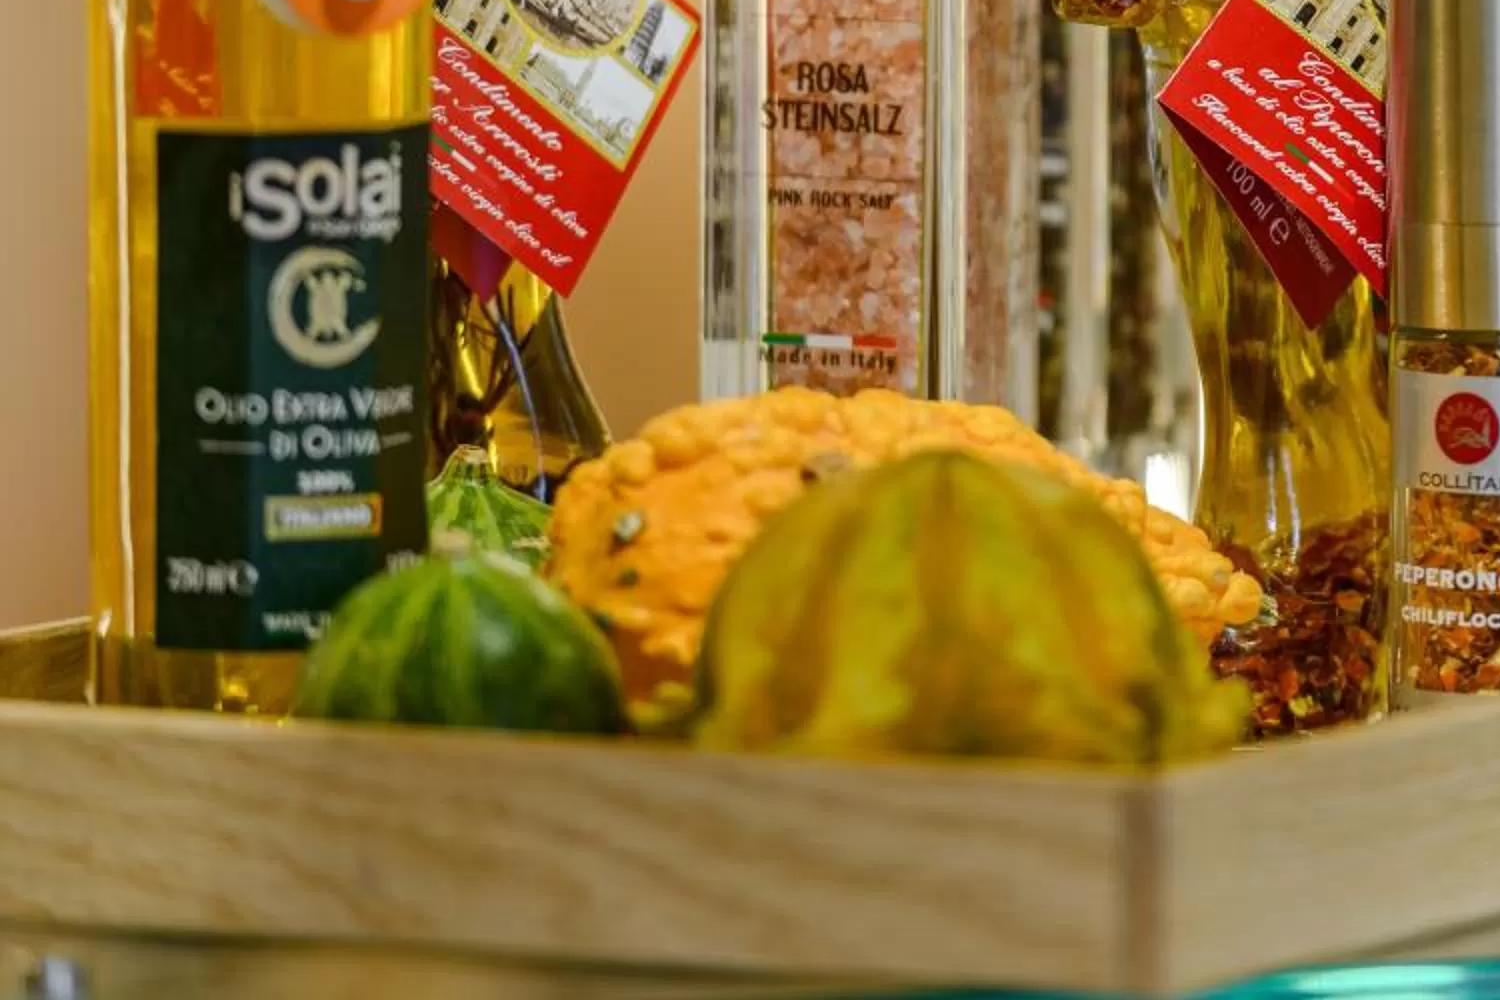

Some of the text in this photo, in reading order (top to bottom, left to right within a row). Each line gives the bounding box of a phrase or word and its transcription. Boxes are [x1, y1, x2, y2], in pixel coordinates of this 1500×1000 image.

[796, 60, 869, 94] ROSA
[1222, 64, 1257, 99] base
[1255, 90, 1277, 114] di
[438, 37, 563, 152] Condimento
[760, 99, 904, 136] STEINSALZ
[1191, 93, 1285, 166] Flavoured
[1257, 66, 1386, 175] al Peperon
[533, 186, 556, 211] di
[858, 192, 895, 211] SALT
[1250, 190, 1272, 222] ml
[540, 243, 571, 268] oil
[820, 348, 843, 366] in
[850, 349, 897, 375] Italy
